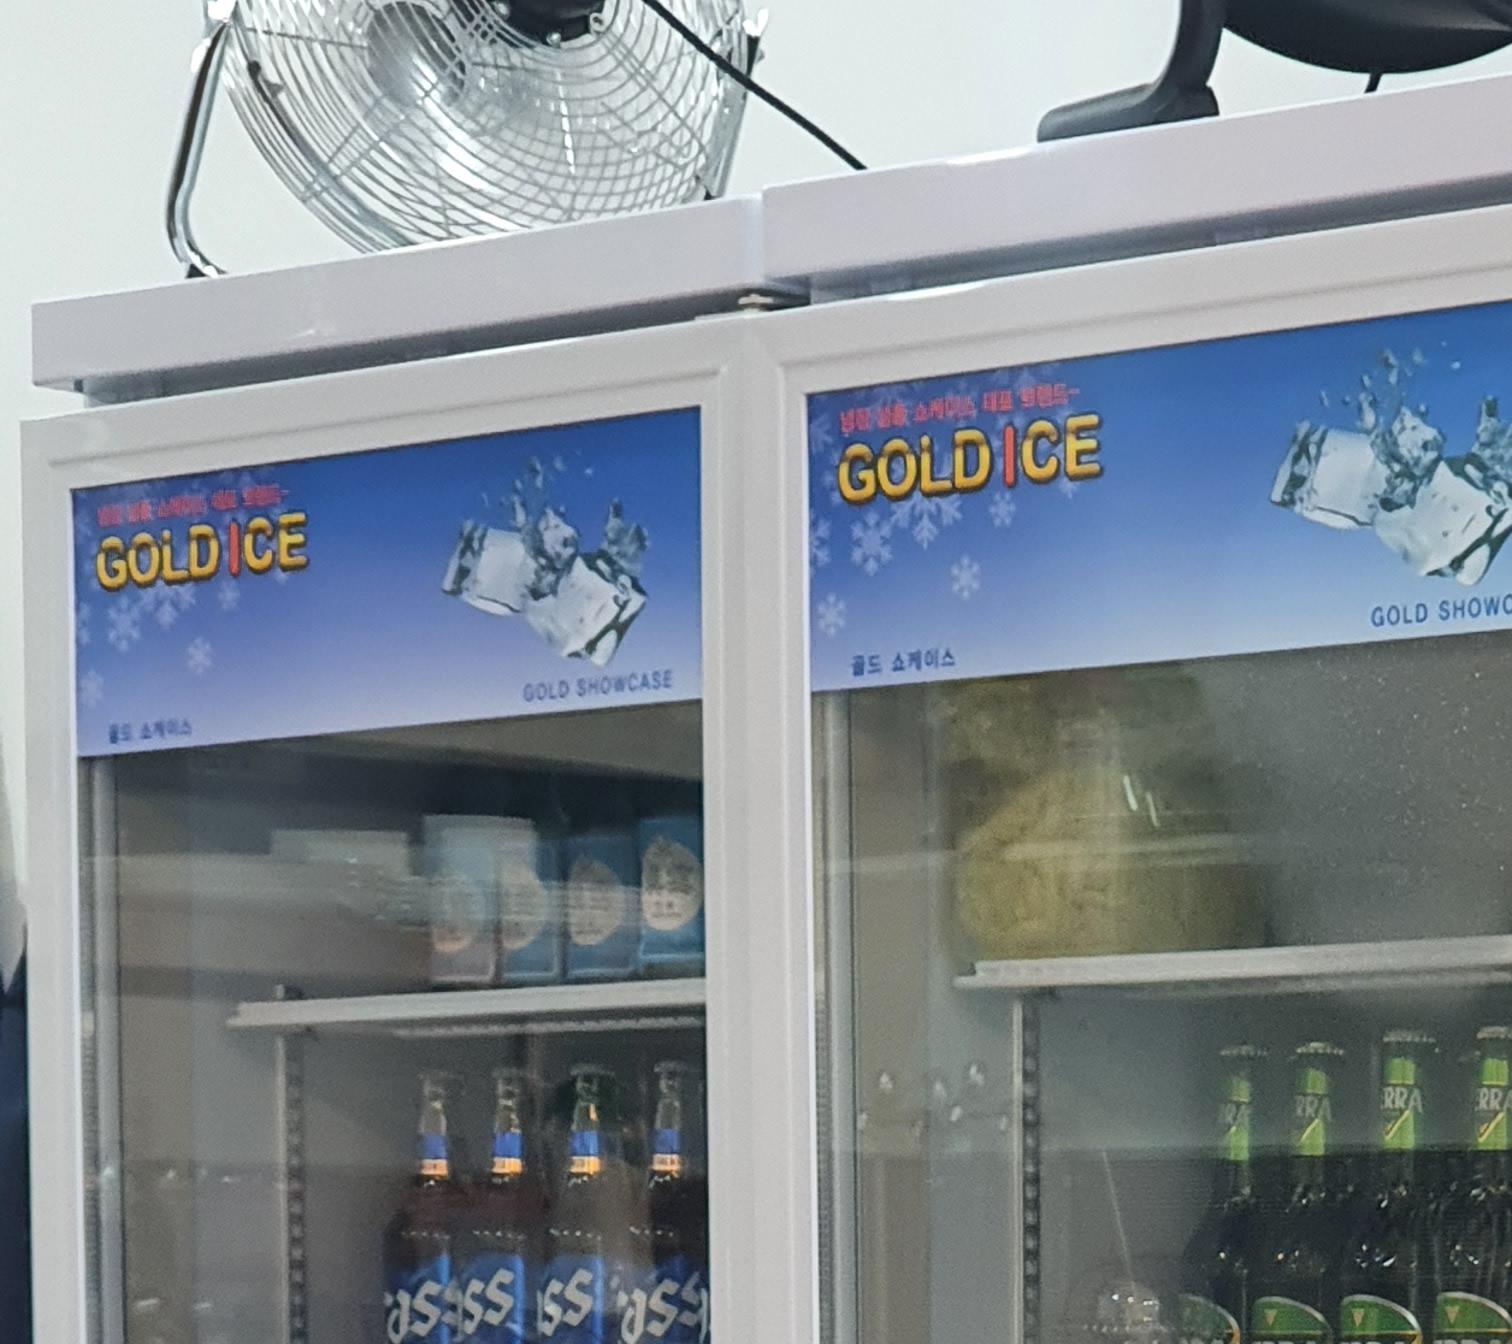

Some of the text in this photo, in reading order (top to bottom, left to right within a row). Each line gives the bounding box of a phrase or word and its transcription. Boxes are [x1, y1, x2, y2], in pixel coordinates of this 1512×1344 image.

[837, 413, 1102, 504] GOLD ICE
[96, 512, 308, 591] GOLD ICE
[1371, 602, 1430, 629] GOLD
[892, 648, 956, 673] 쇼케이스
[522, 669, 674, 702] GOLD SHOWCASE
